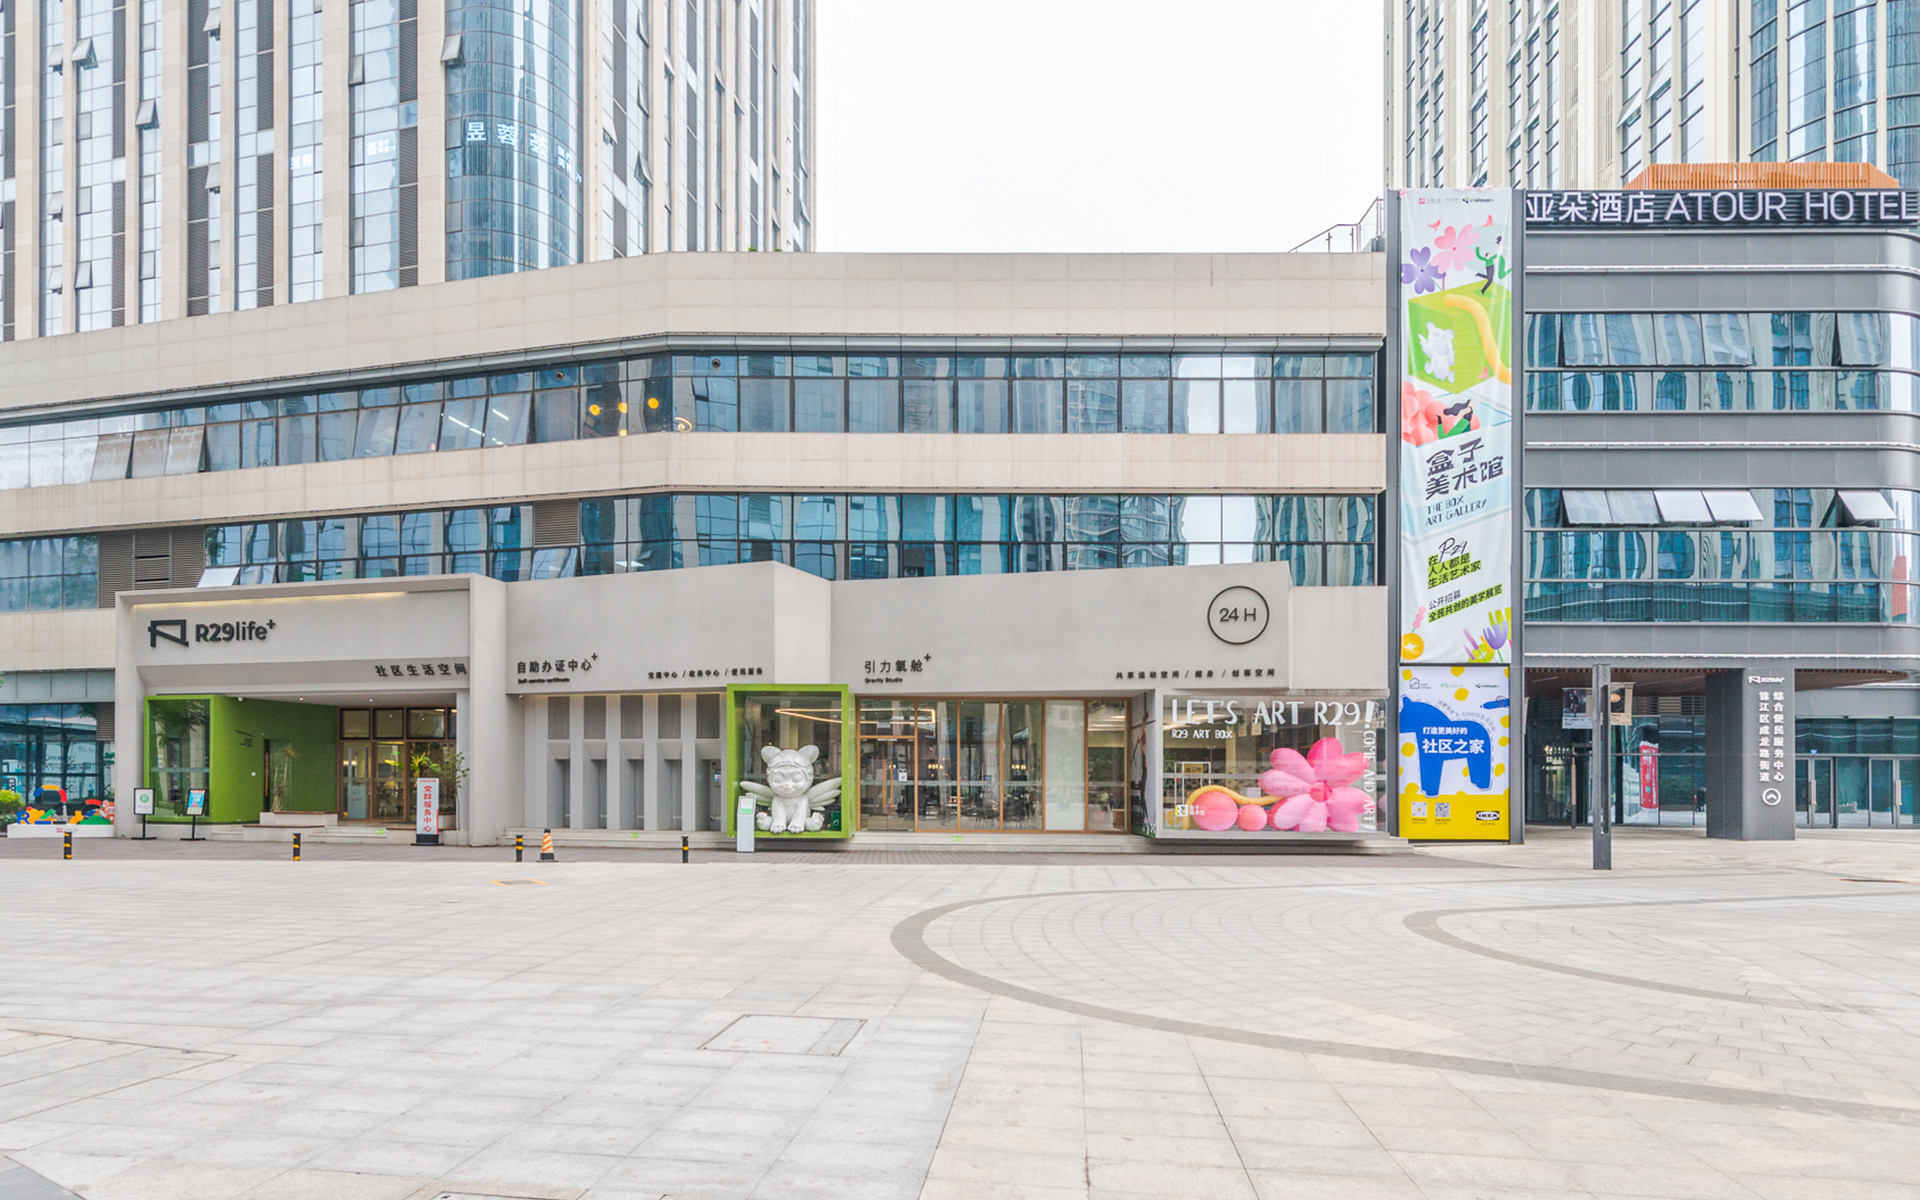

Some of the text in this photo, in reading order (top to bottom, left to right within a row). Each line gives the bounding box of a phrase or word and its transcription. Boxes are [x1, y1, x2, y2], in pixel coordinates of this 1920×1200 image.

[1525, 191, 1920, 224] 亚朵酒店 ATOUR HOTEL
[1426, 437, 1484, 476] 盒子
[1426, 456, 1504, 500] 美术馆
[1426, 499, 1488, 526] ART GALLERY
[1427, 496, 1464, 515] THE BOX
[1428, 552, 1470, 577] 人人都是
[1428, 561, 1481, 589] 生活艺术家
[1219, 608, 1257, 622] 24 H
[375, 663, 467, 677] 社区生活空间
[1254, 701, 1304, 725] ART
[1171, 729, 1189, 739] R29
[1192, 729, 1211, 739] ART
[1422, 727, 1468, 735] 打造更美好的
[1773, 691, 1785, 782] 综合便民服务中心
[1363, 730, 1377, 763] COME
[1422, 739, 1485, 754] 社区之家
[1363, 769, 1377, 793] AND
[423, 785, 432, 832] 党群服务中心
